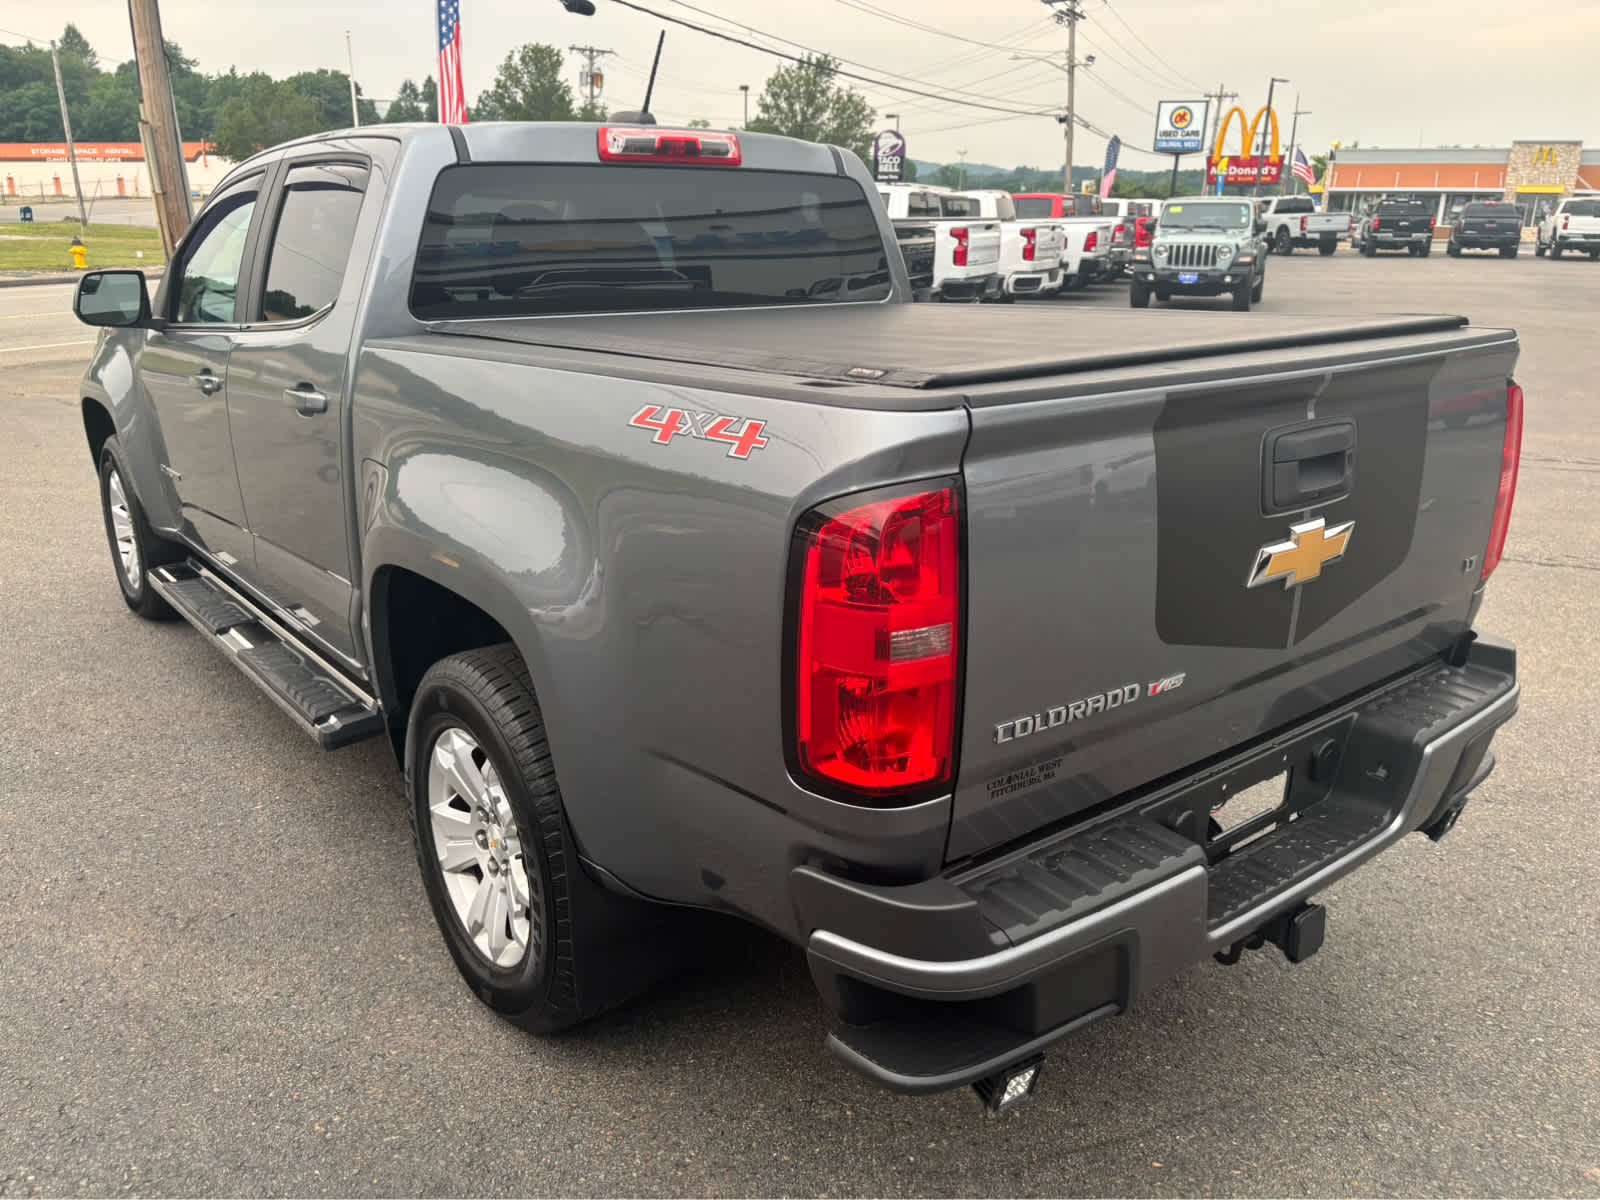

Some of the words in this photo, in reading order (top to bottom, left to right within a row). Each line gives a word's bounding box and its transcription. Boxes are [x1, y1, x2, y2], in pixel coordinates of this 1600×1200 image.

[877, 156, 901, 164] TACO
[878, 164, 900, 172] BELL
[992, 683, 1141, 744] COLORADO
[986, 768, 1037, 791] COLONIAL
[1037, 758, 1064, 774] WEST
